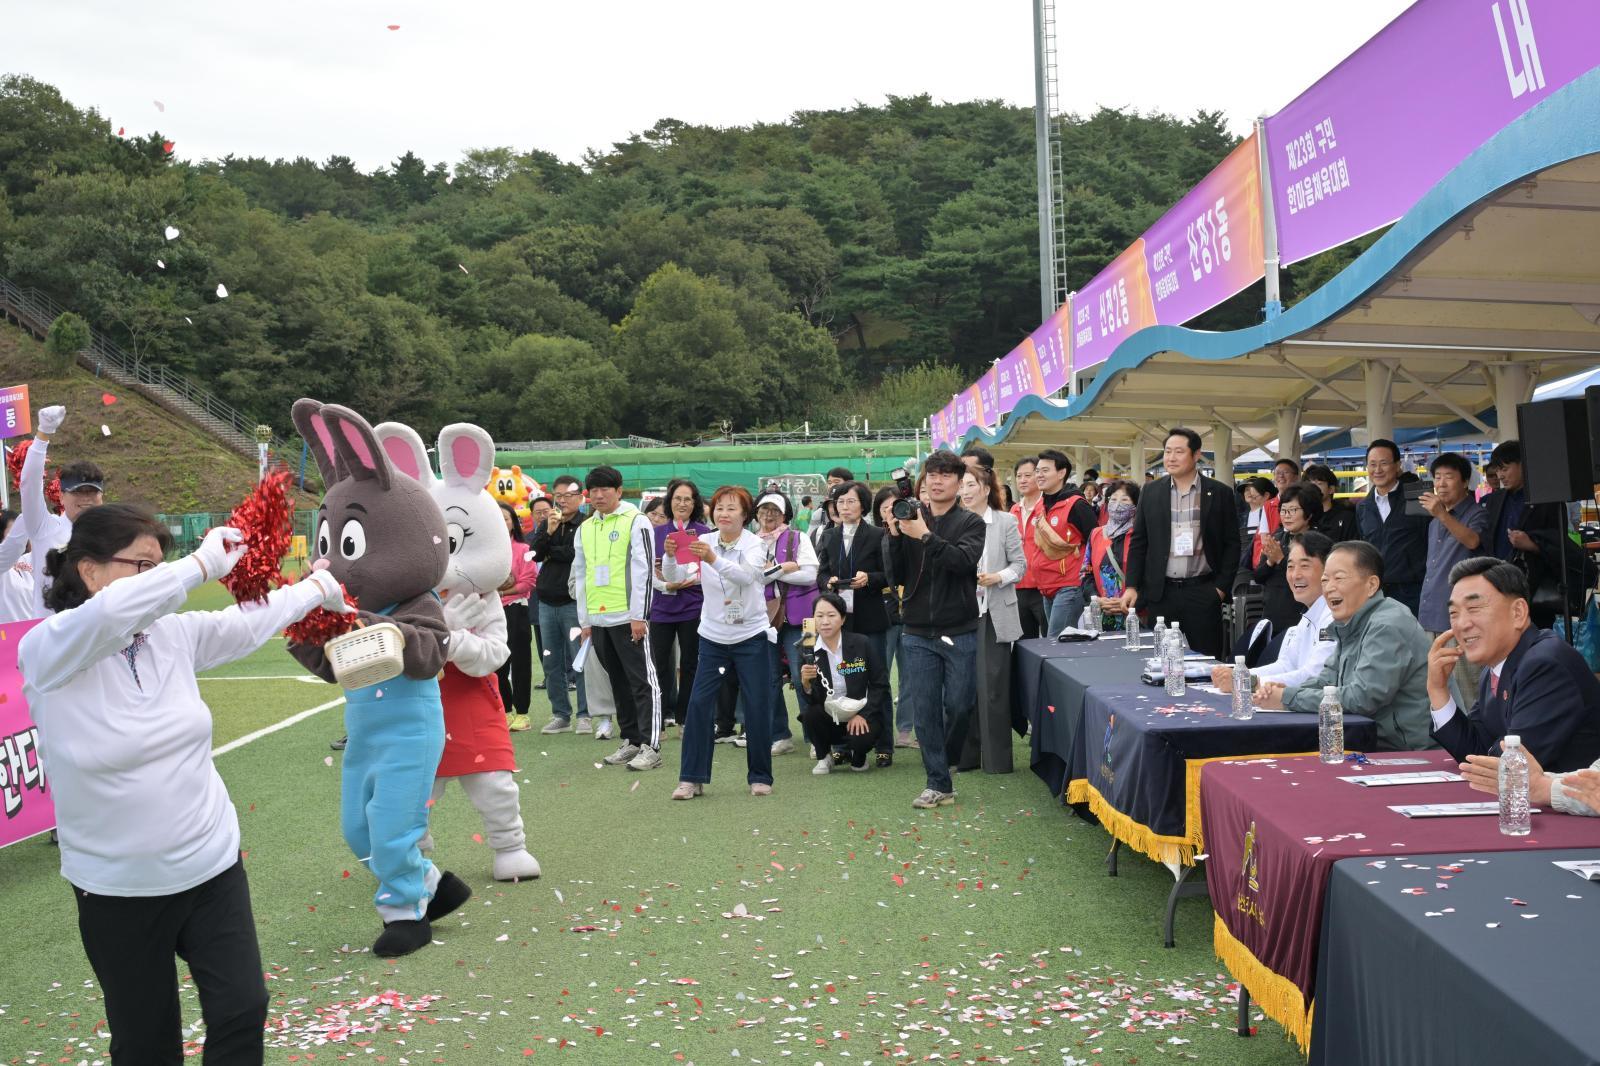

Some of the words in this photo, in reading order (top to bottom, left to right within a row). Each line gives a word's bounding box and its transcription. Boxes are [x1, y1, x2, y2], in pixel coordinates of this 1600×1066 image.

[1285, 130, 1317, 172] 제23회
[1315, 115, 1337, 155] 구민
[1286, 156, 1350, 215] 한마음체육대회
[1186, 196, 1232, 283] 신정1동
[1099, 278, 1130, 337] 신정2동
[6, 408, 16, 428] 동
